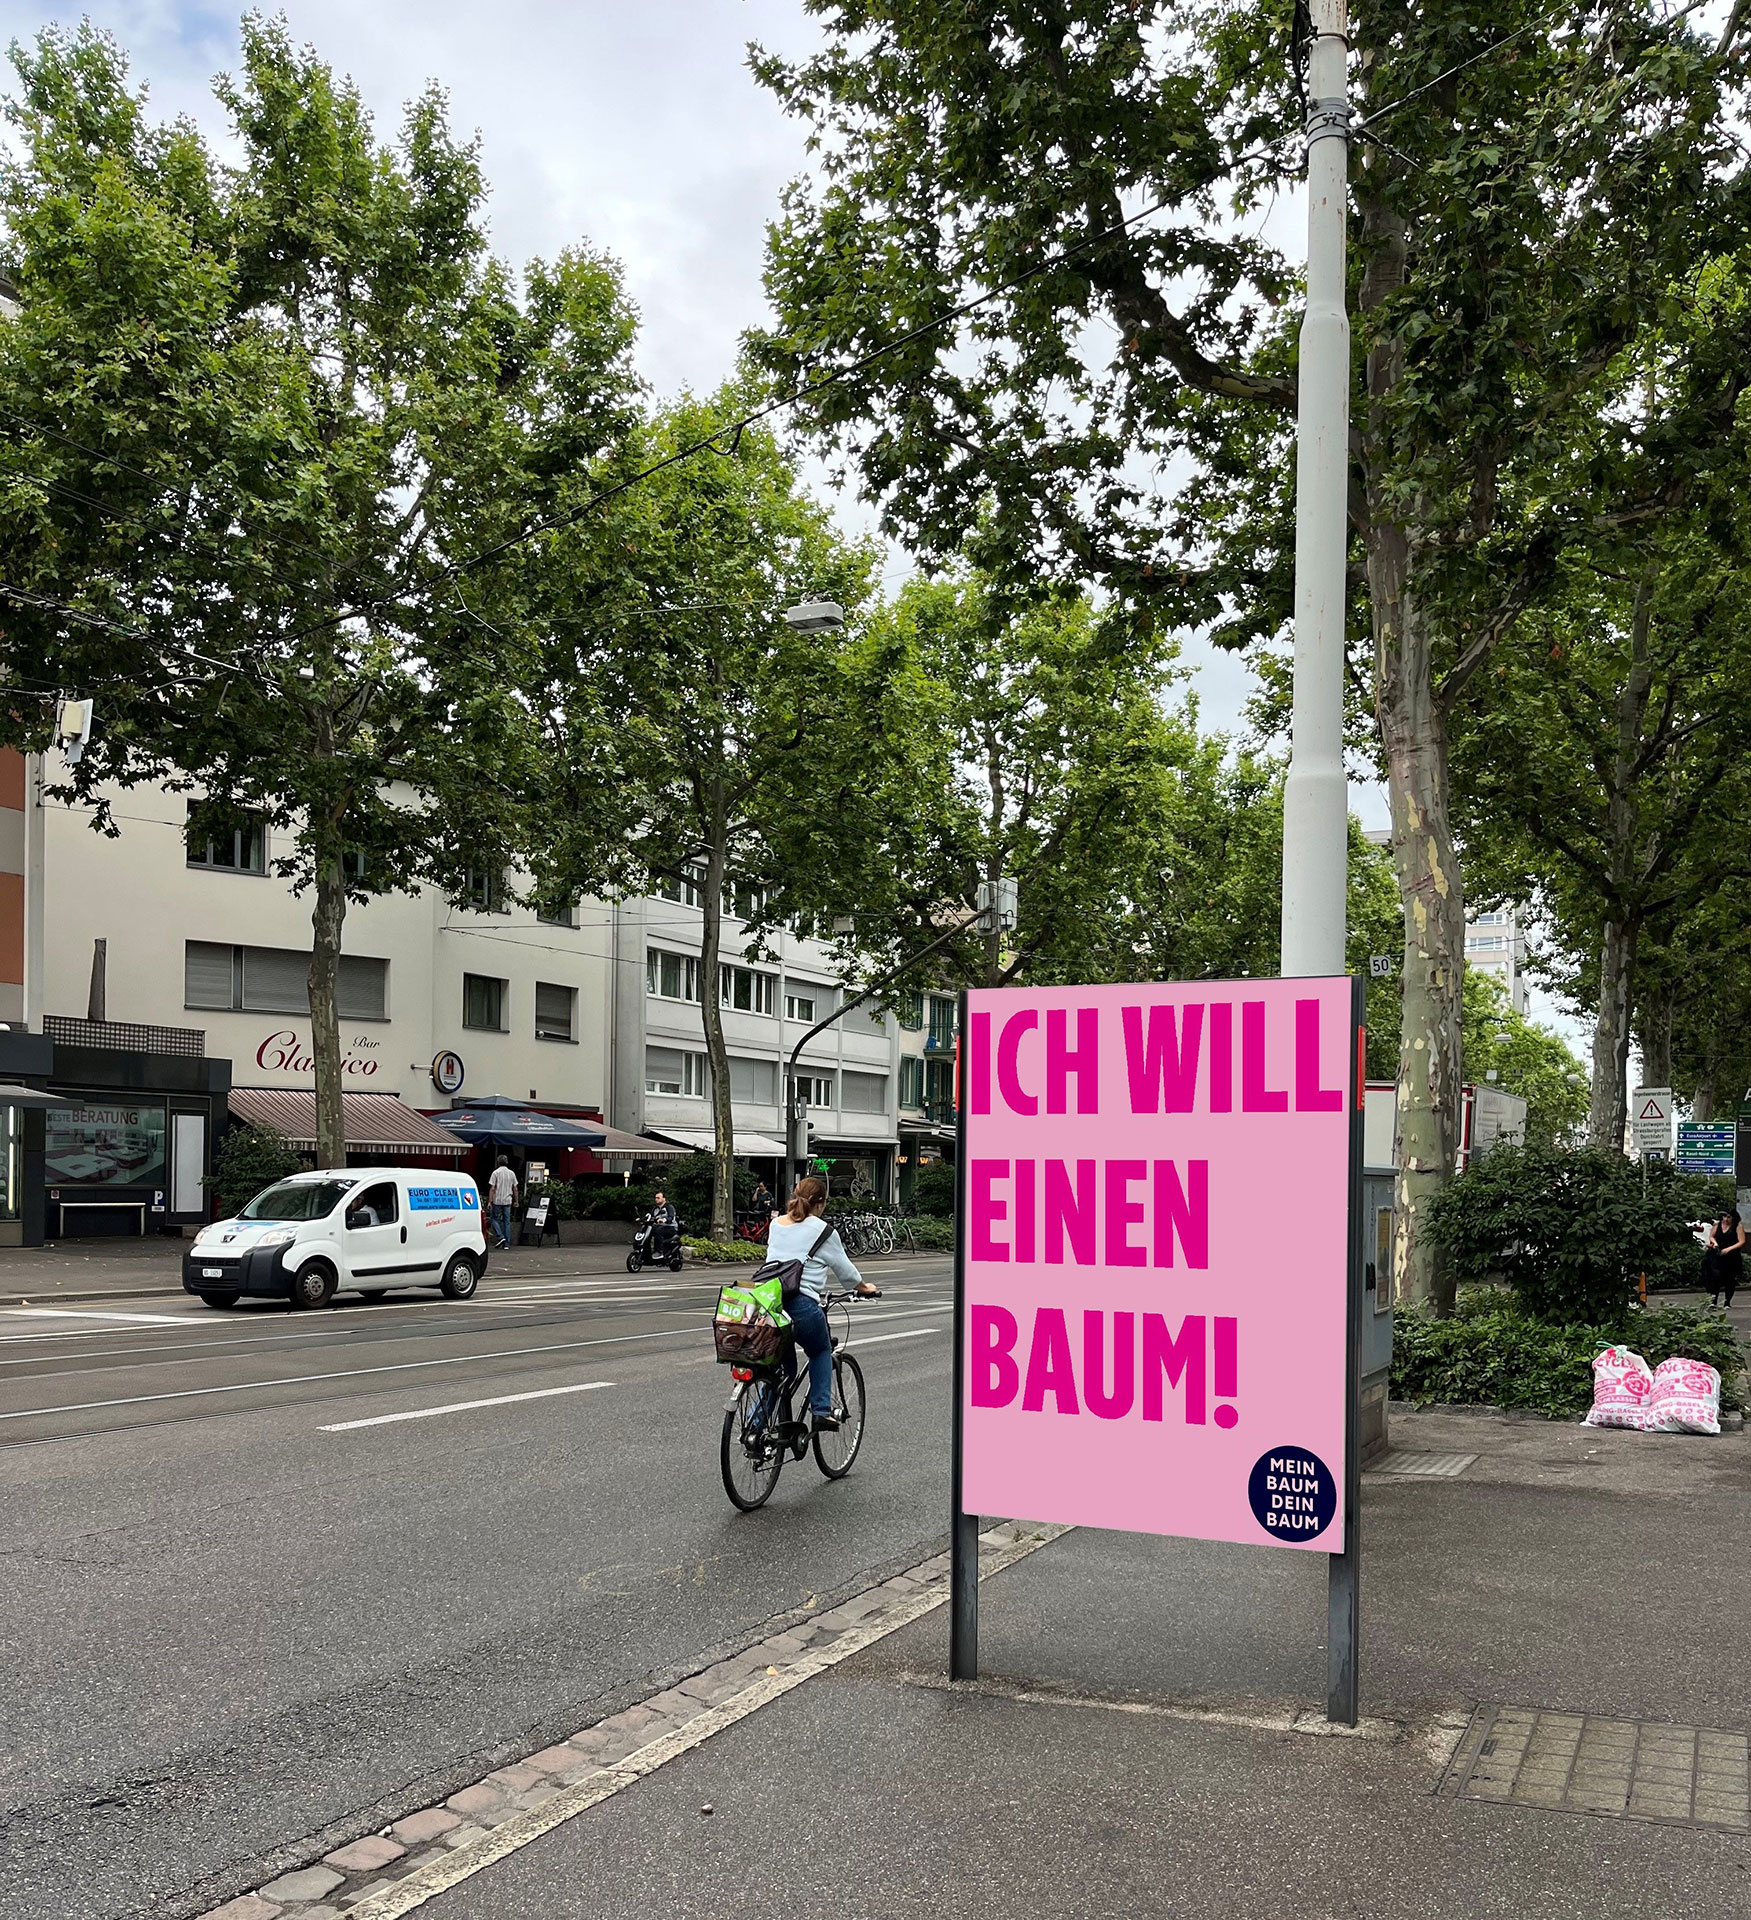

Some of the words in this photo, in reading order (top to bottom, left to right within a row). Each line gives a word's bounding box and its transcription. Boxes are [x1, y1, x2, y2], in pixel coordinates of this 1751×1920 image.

[1372, 958, 1389, 972] 50
[353, 1036, 380, 1049] Bar
[256, 1030, 382, 1076] Claico
[971, 1007, 1098, 1116] ICH
[1121, 999, 1343, 1114] WILL
[72, 1110, 138, 1125] BERATUNG
[154, 1190, 164, 1205] P
[409, 1189, 429, 1197] EURO
[434, 1189, 458, 1197] CLEAN
[971, 1159, 1209, 1270] EINEN
[722, 1303, 741, 1318] BIO
[971, 1304, 1239, 1430] BAUM!
[1270, 1457, 1315, 1476] MEIN
[1266, 1475, 1319, 1495] BAUM
[1271, 1494, 1314, 1512] DEIN
[1266, 1512, 1319, 1531] BAUM
